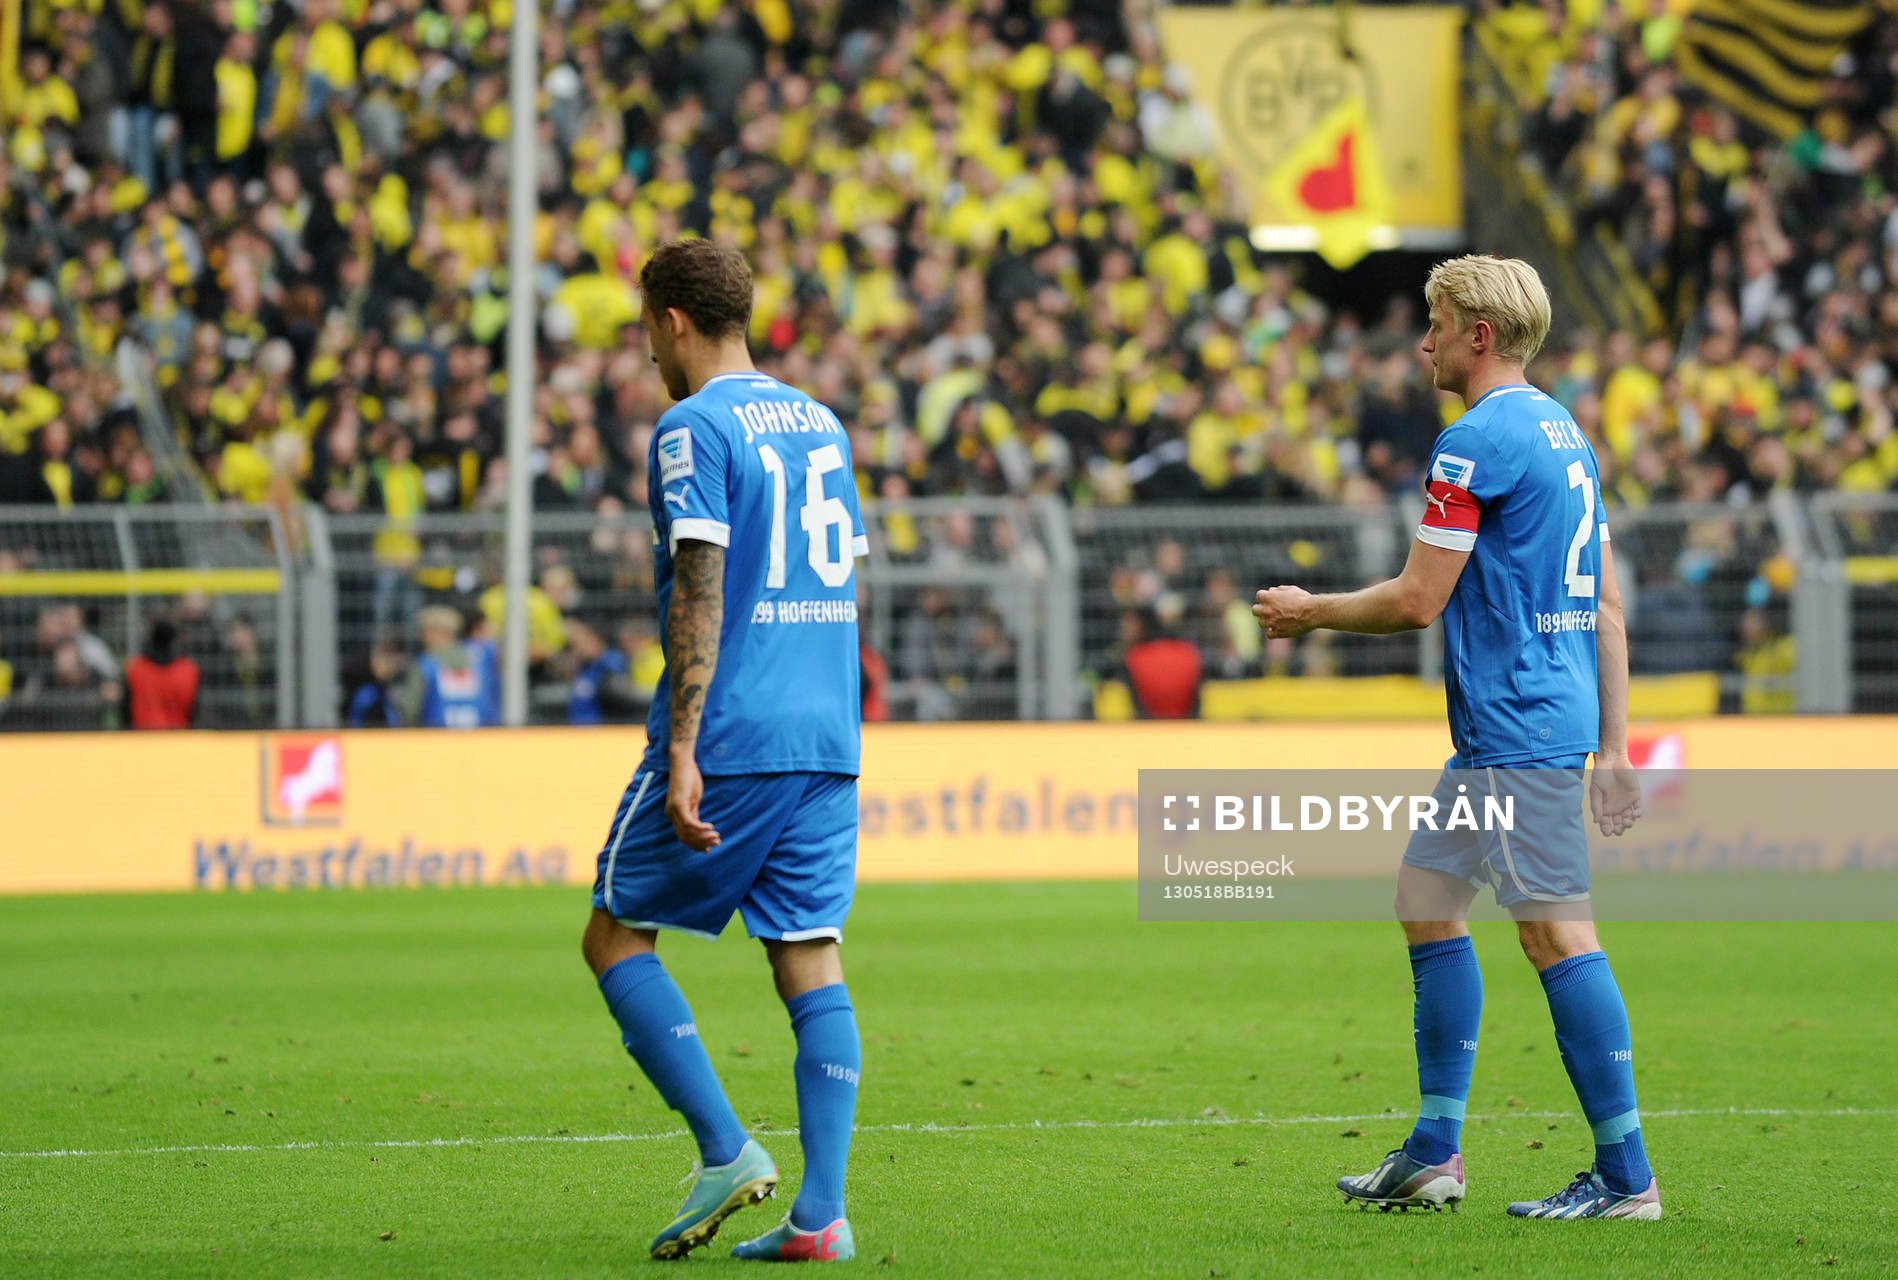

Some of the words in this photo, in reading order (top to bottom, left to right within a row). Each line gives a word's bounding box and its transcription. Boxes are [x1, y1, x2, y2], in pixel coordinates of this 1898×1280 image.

[732, 400, 839, 444] JOHNSON
[1539, 420, 1587, 449] BECK
[758, 443, 854, 589] 16
[1564, 459, 1595, 598] 2
[193, 835, 485, 888] Westfalen
[503, 847, 569, 887] AG
